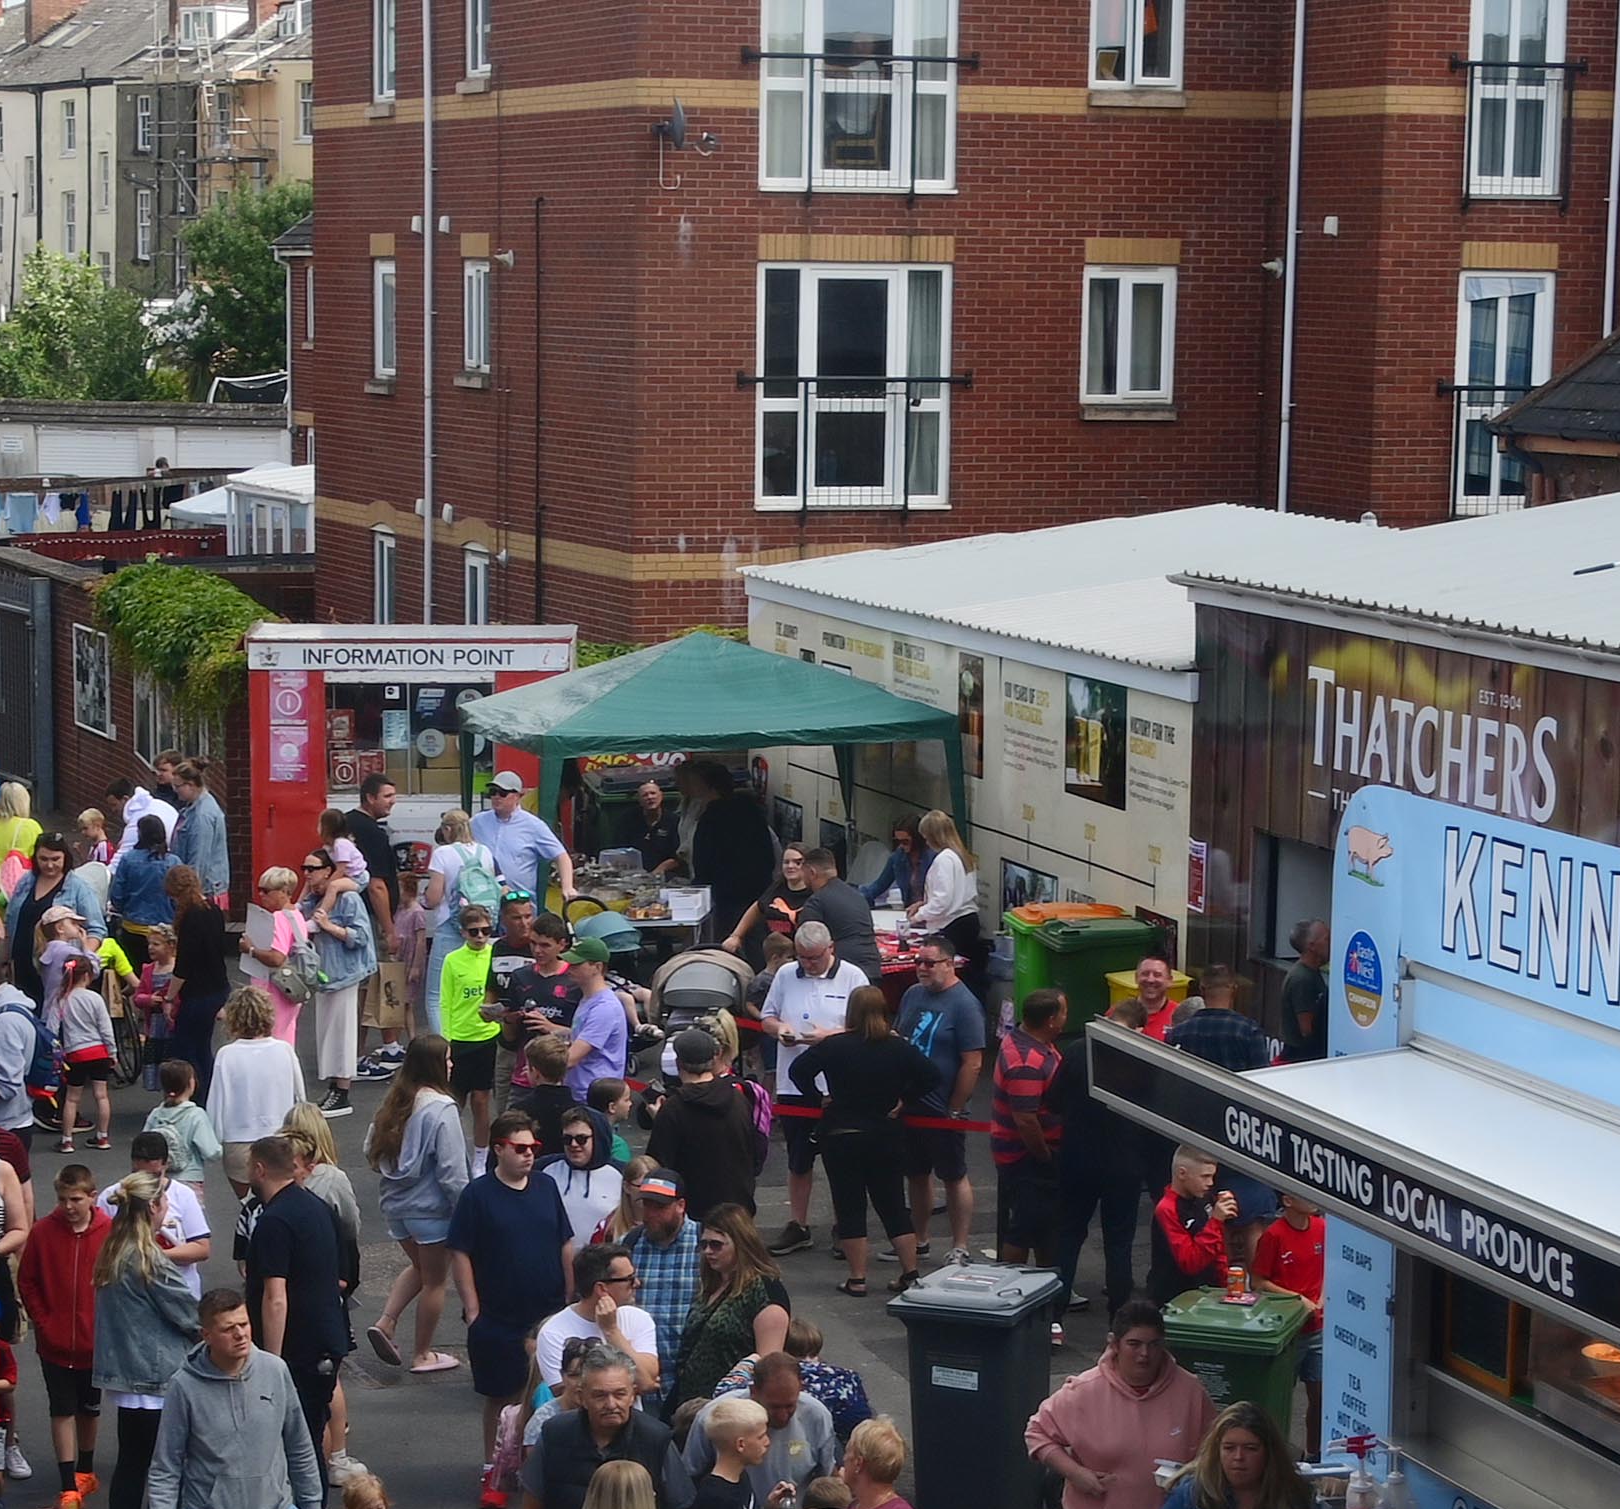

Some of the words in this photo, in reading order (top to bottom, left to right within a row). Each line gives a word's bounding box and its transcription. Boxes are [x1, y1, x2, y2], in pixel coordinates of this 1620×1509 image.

[302, 648, 445, 666] INFORMATION
[453, 649, 515, 666] POINT
[1479, 689, 1497, 706] EST.
[1499, 693, 1522, 711] 1904
[1306, 665, 1558, 824] THATCHERS
[1331, 788, 1352, 812] TH
[1224, 1105, 1283, 1168] GREAT
[1289, 1131, 1374, 1208] TASTING
[1383, 1173, 1452, 1243] LOCAL
[1461, 1207, 1576, 1300] PRODUCE
[1342, 1244, 1355, 1264] EGG
[1355, 1250, 1373, 1272] BAPS
[1346, 1289, 1366, 1311] CHIPS
[1333, 1324, 1358, 1351] CHEESY
[1358, 1338, 1378, 1360] CHIPS
[1348, 1373, 1362, 1393] TEA
[1341, 1391, 1367, 1418] COFFEE
[1337, 1410, 1351, 1431] HOT
